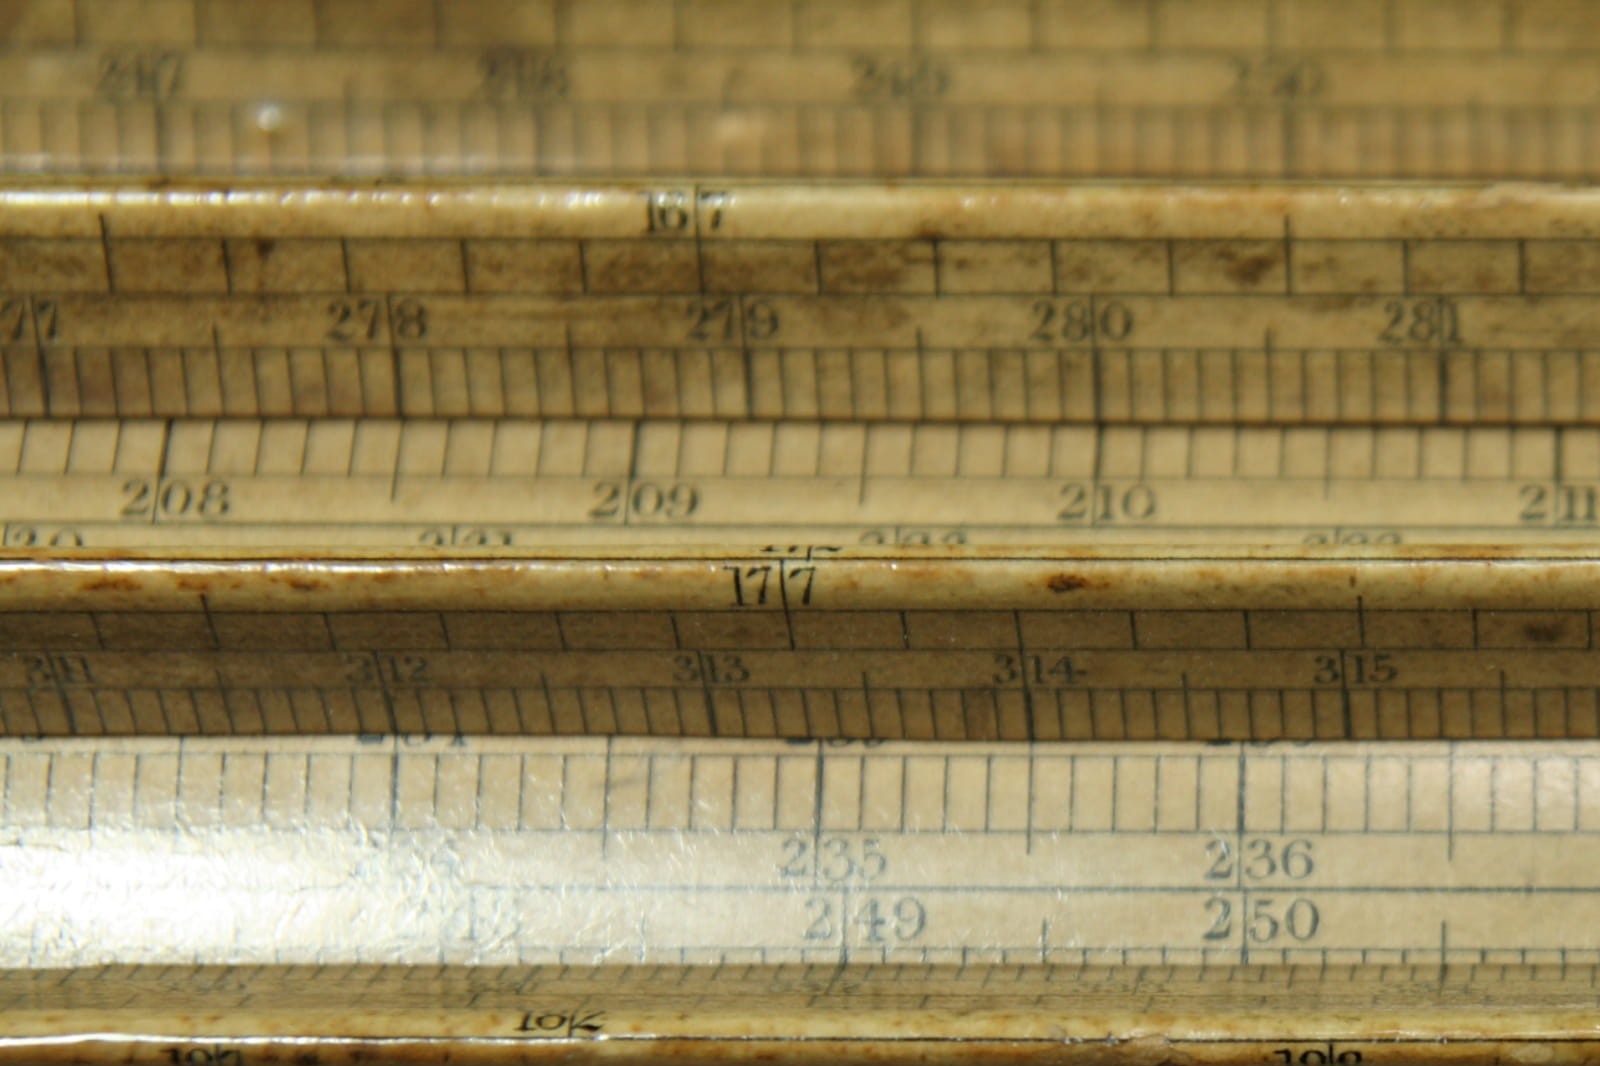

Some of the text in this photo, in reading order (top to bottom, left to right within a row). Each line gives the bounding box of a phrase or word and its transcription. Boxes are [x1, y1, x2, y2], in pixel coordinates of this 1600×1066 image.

[328, 301, 429, 341] 278
[686, 301, 780, 340] 279
[1030, 302, 1133, 342] 280
[1378, 302, 1463, 342] 281
[118, 479, 233, 518] 208
[588, 480, 698, 519] 209
[1057, 483, 1158, 521] 210
[1518, 484, 1598, 522] 211
[724, 566, 814, 608] 177
[345, 656, 432, 685] 312
[674, 654, 750, 685] 313
[992, 655, 1088, 685] 314
[1313, 654, 1399, 685] 315
[780, 837, 886, 881] 235
[1203, 838, 1315, 881] 236
[803, 898, 926, 942] 249
[1202, 898, 1319, 941] 250
